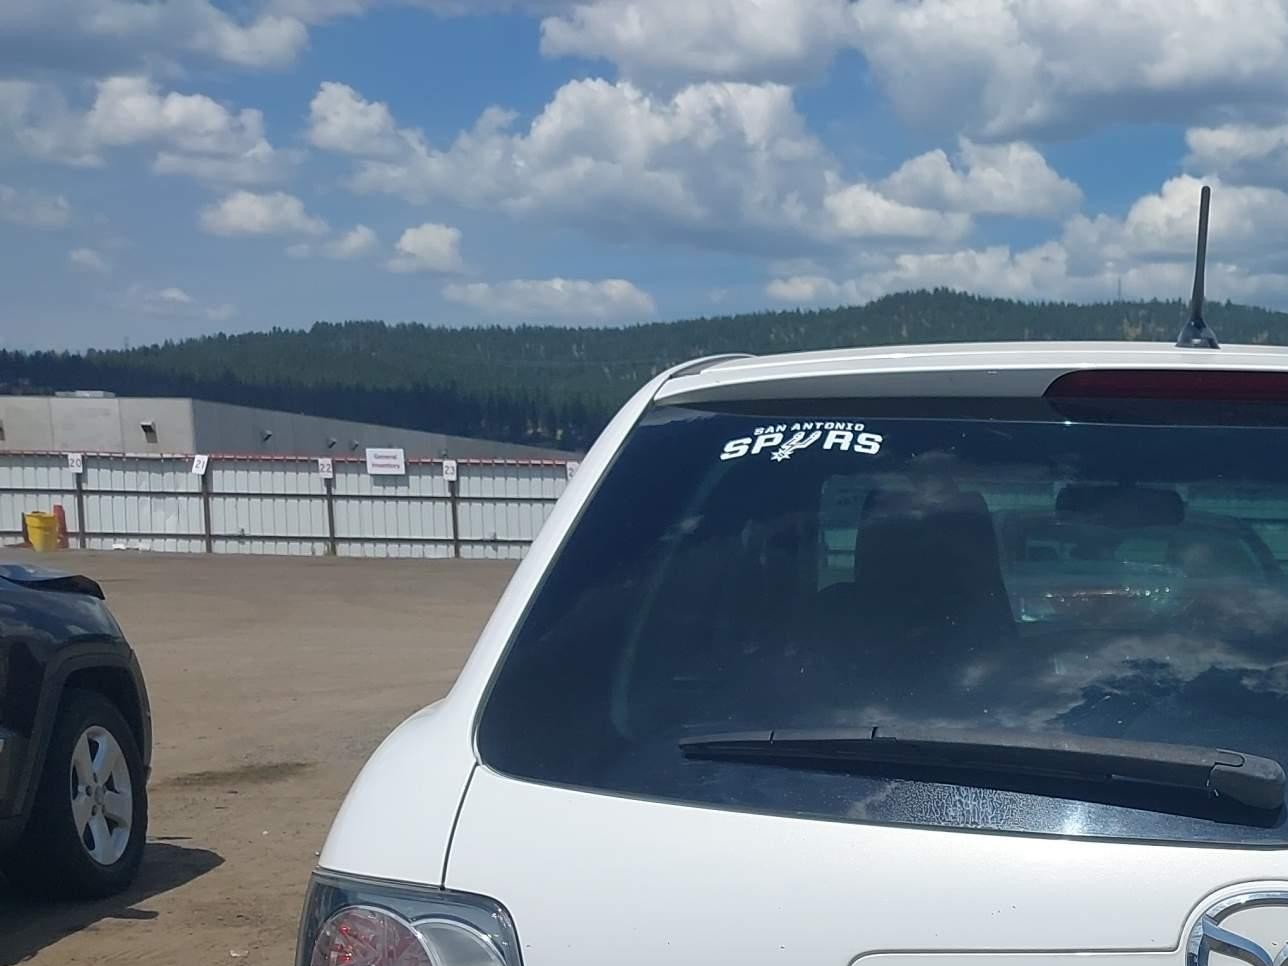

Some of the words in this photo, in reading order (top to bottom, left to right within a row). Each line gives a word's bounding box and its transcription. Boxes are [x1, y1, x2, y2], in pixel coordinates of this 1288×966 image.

[754, 424, 786, 436] SAN
[791, 421, 865, 431] ANTONIO
[720, 431, 883, 462] SPURS
[69, 458, 81, 468] 20
[195, 459, 205, 468] 21
[320, 463, 332, 473] 22
[444, 465, 456, 475] 23
